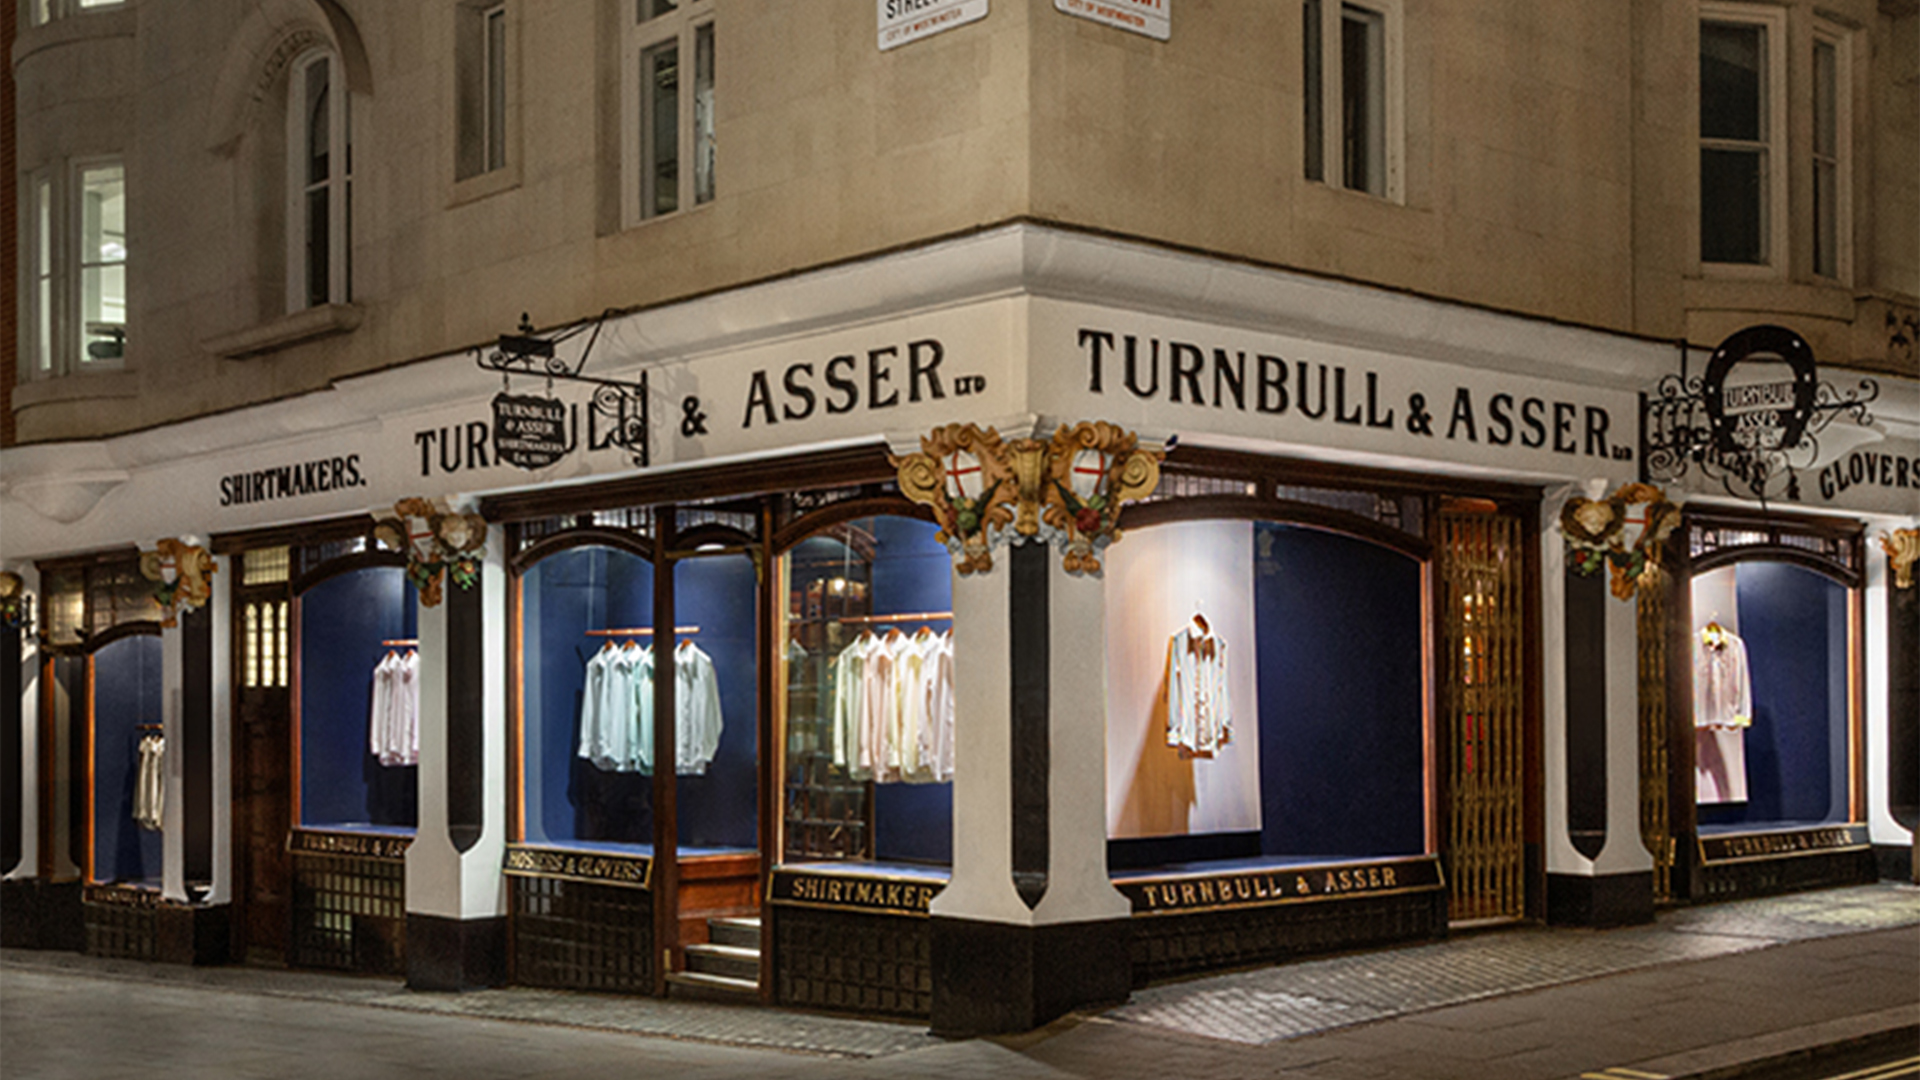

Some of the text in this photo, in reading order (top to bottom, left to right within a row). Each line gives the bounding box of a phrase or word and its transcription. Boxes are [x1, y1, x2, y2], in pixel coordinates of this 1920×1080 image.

[680, 395, 709, 438] &
[742, 338, 946, 429] ASSER
[954, 375, 987, 397] LTD
[1077, 328, 1394, 431] TURNBULL
[1405, 391, 1433, 438] &
[1446, 386, 1610, 459] ASSER
[516, 420, 556, 436] ASSER
[219, 454, 367, 507] SHIRTMAKERS.
[792, 877, 936, 908] SHIRTMAKER
[1143, 866, 1397, 907] TURNBULL & ASSER
